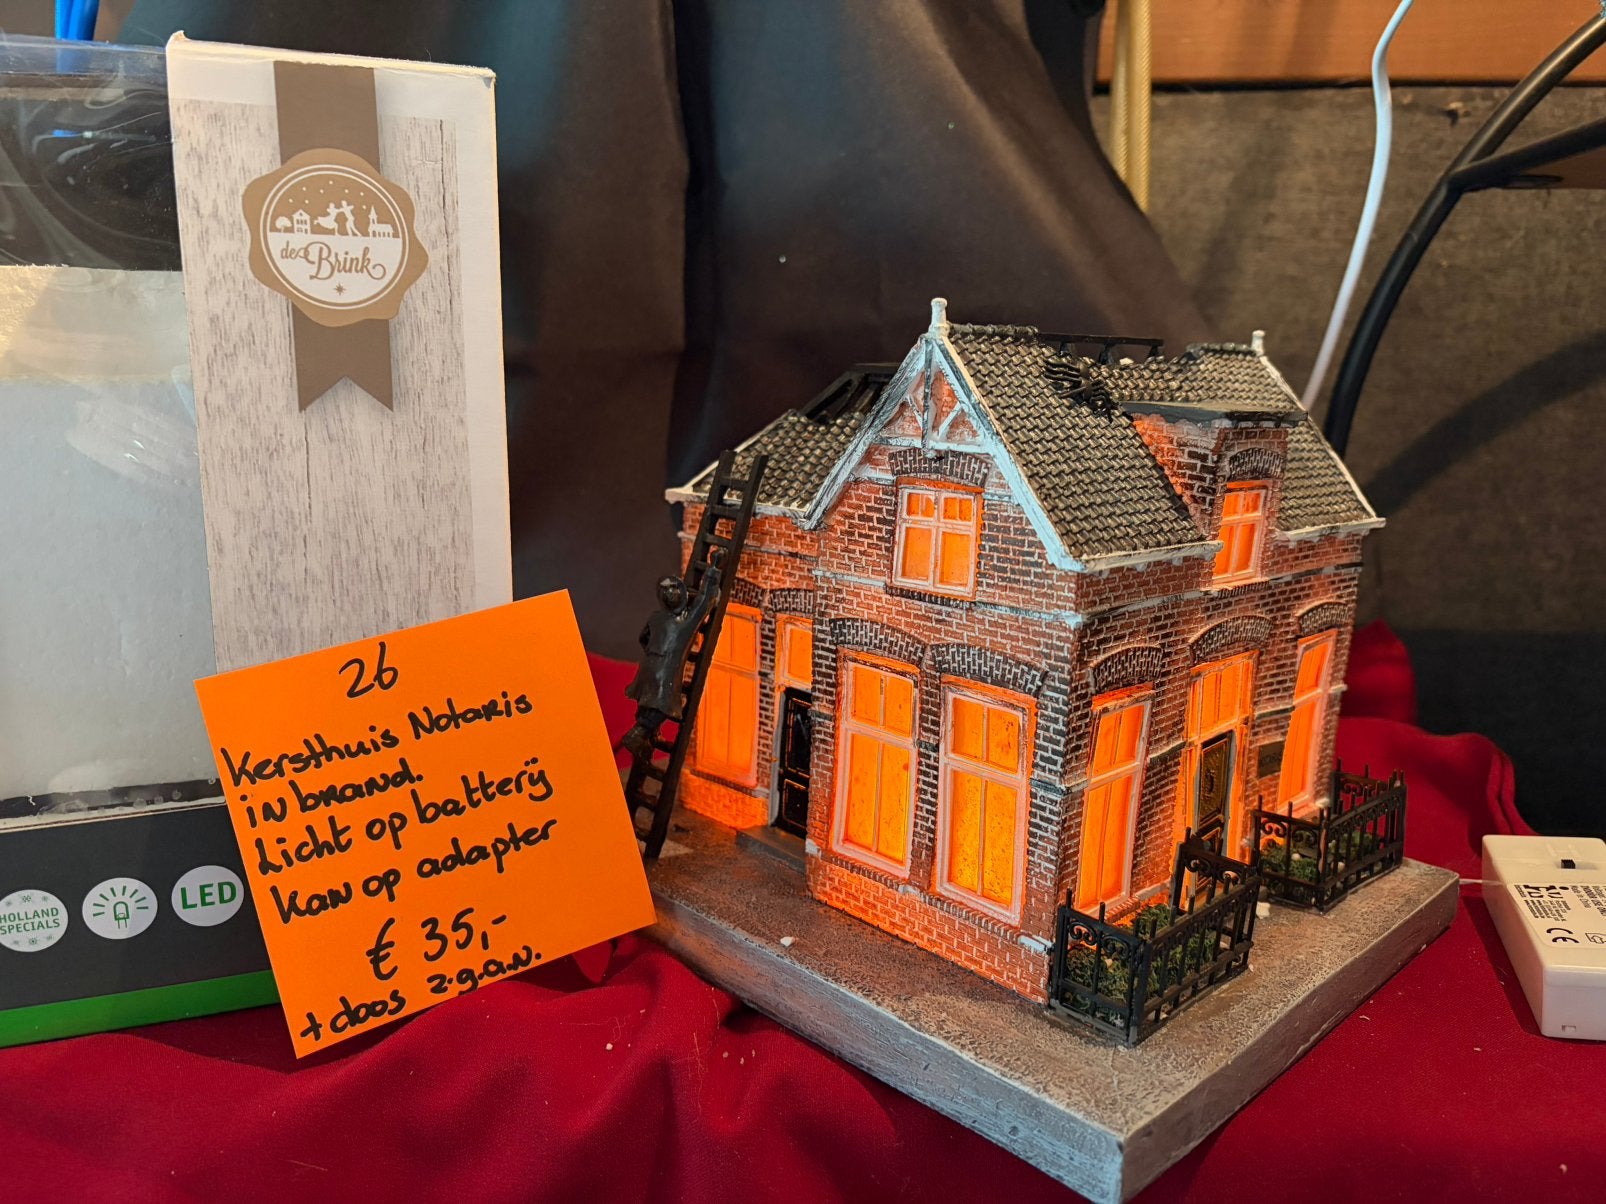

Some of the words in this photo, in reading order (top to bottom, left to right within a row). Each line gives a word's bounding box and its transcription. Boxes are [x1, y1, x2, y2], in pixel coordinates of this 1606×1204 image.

[302, 241, 387, 281] Brink
[338, 641, 399, 699] 26
[220, 725, 400, 788] Kersthuis
[407, 690, 534, 741] Notaris
[255, 815, 353, 876] Licht
[365, 812, 408, 851] op
[361, 868, 402, 903] op
[416, 818, 558, 879] adapter
[0, 907, 59, 924] HOLLAND
[181, 881, 237, 910] LED
[0, 918, 61, 936] SPECIALS
[365, 917, 399, 981] €
[329, 989, 407, 1034] doos
